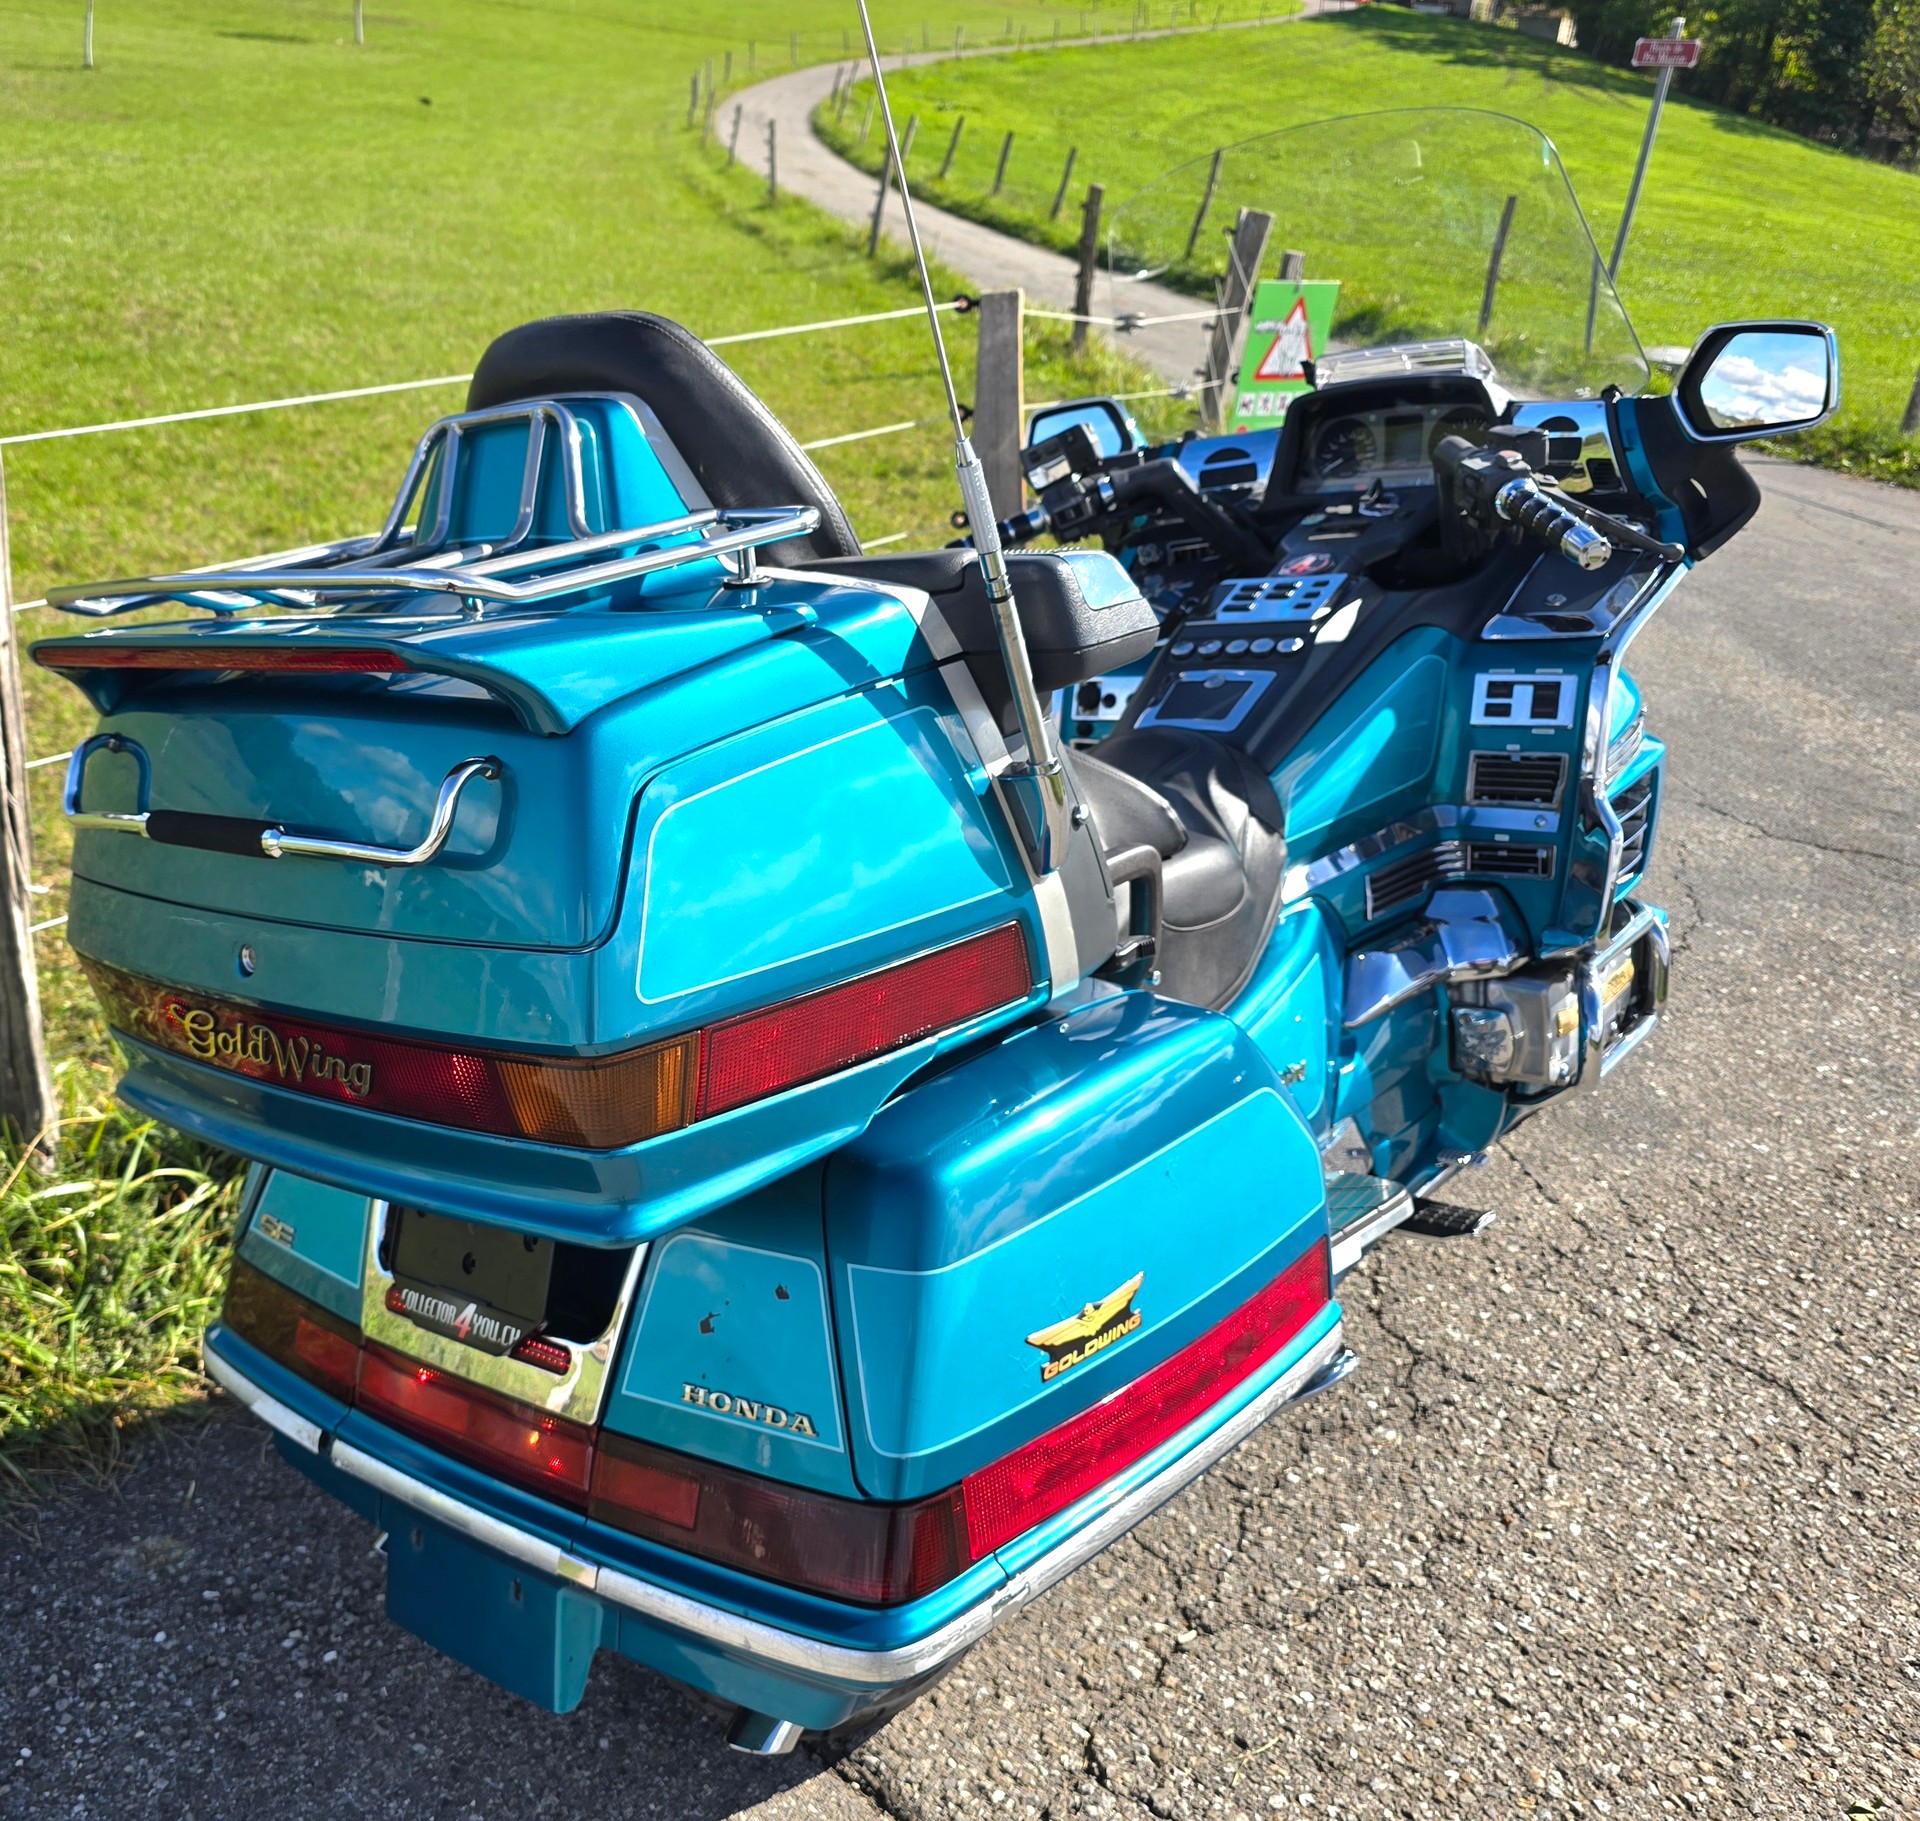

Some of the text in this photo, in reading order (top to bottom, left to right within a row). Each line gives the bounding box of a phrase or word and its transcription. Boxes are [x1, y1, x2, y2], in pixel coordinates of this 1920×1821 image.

[168, 1003, 372, 1097] GoldWing
[1042, 1313, 1142, 1381] GOLDWING
[681, 1383, 818, 1438] HONDA
